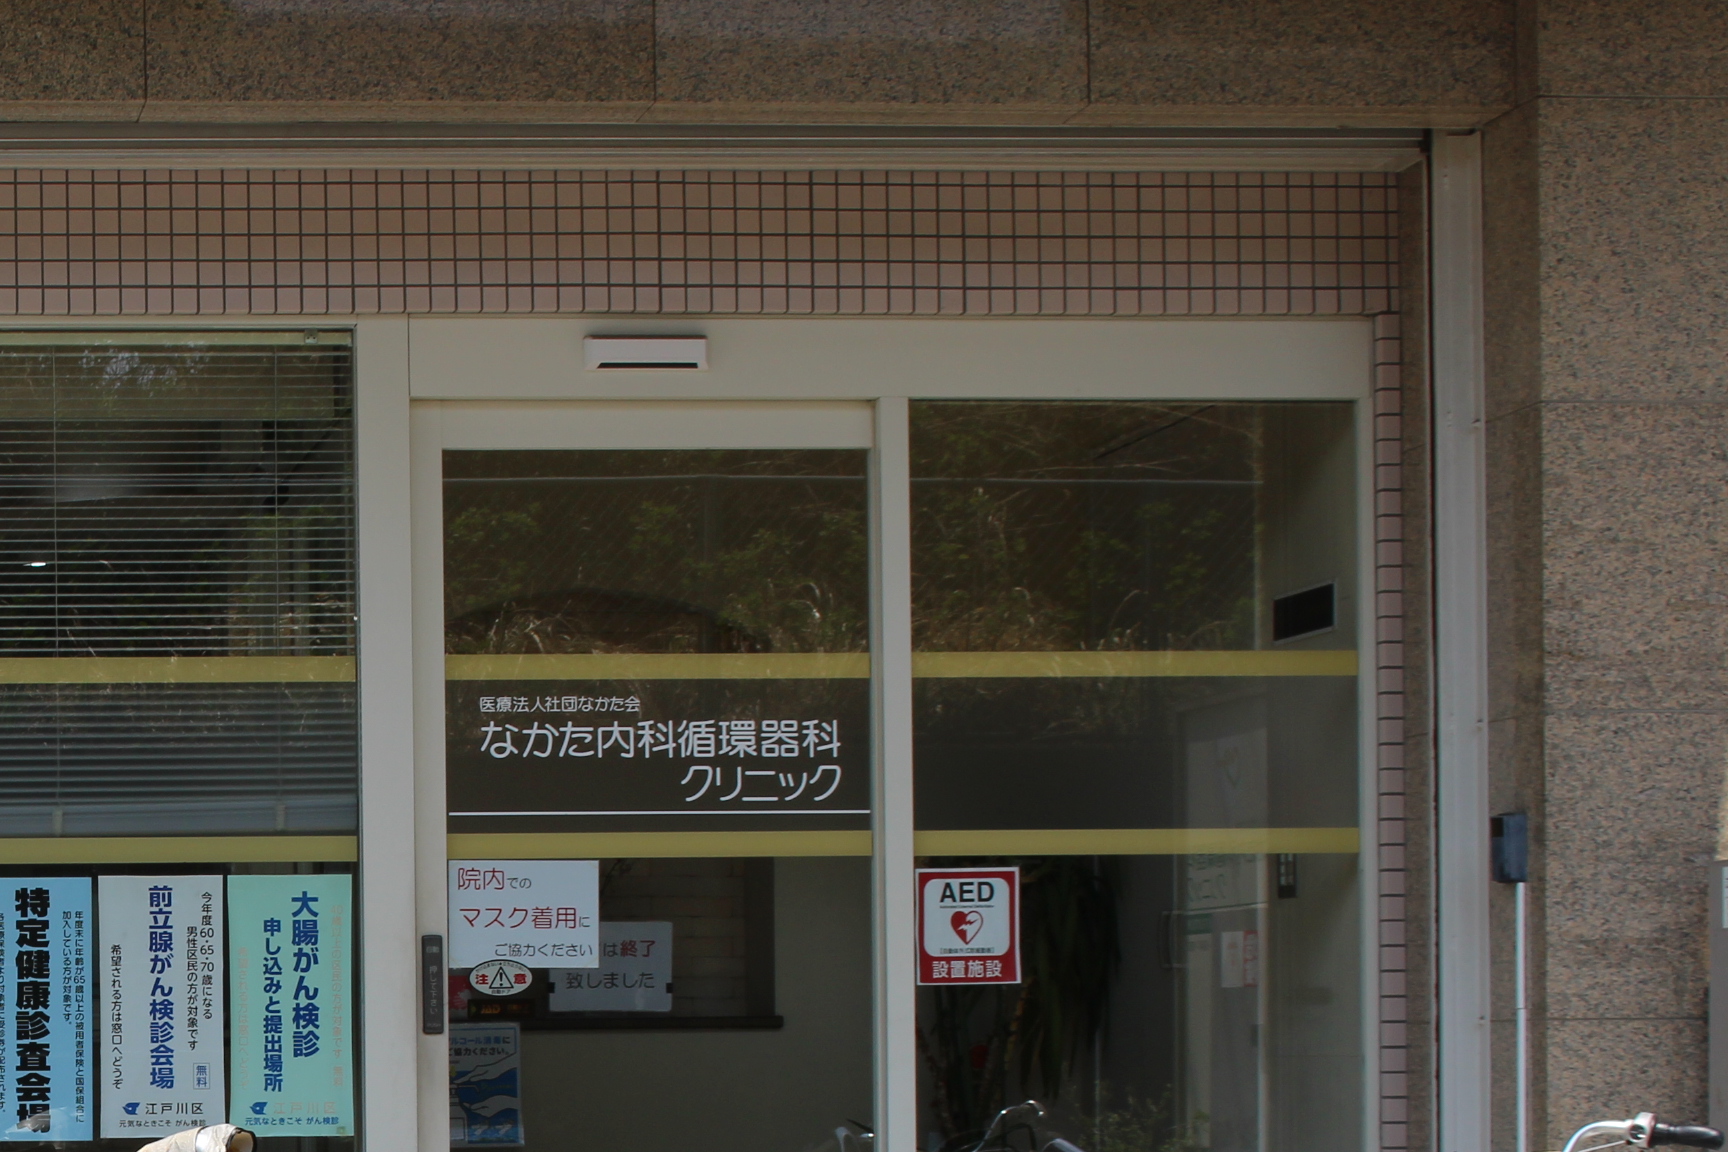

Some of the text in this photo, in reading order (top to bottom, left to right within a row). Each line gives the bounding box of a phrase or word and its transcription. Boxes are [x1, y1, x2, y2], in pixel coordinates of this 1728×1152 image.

[478, 695, 641, 714] 医療法人社団なかた会
[479, 718, 842, 760] なかた内科循環器科
[679, 764, 843, 803] クリニック
[456, 866, 533, 892] 院内での
[939, 881, 995, 903] AED
[459, 905, 591, 931] マスク着用に
[493, 941, 594, 959] ご協力ください
[62, 910, 73, 1026] 加入している方が対象です。
[290, 890, 321, 1059] 大腸がん検診
[565, 971, 656, 990] 致しました
[932, 959, 1003, 979] 設置施設
[148, 885, 176, 1090] 前立腺がん検診会場
[186, 926, 199, 1051] 男性区民の方が対象です
[14, 887, 51, 1134] 特定健康診査会場
[110, 944, 123, 1090] 希望される方は窓口へどうぞ
[262, 917, 284, 1093] 申し込みと提出場所
[449, 1036, 511, 1045] ルコール消毒に
[196, 1064, 208, 1088] 無料
[144, 1102, 205, 1116] 江戸川区
[273, 1101, 337, 1116] 江戸川区
[118, 1118, 208, 1129] 元気なときこそ がん検診
[244, 1116, 340, 1127] 元気なときこそ がん検診
